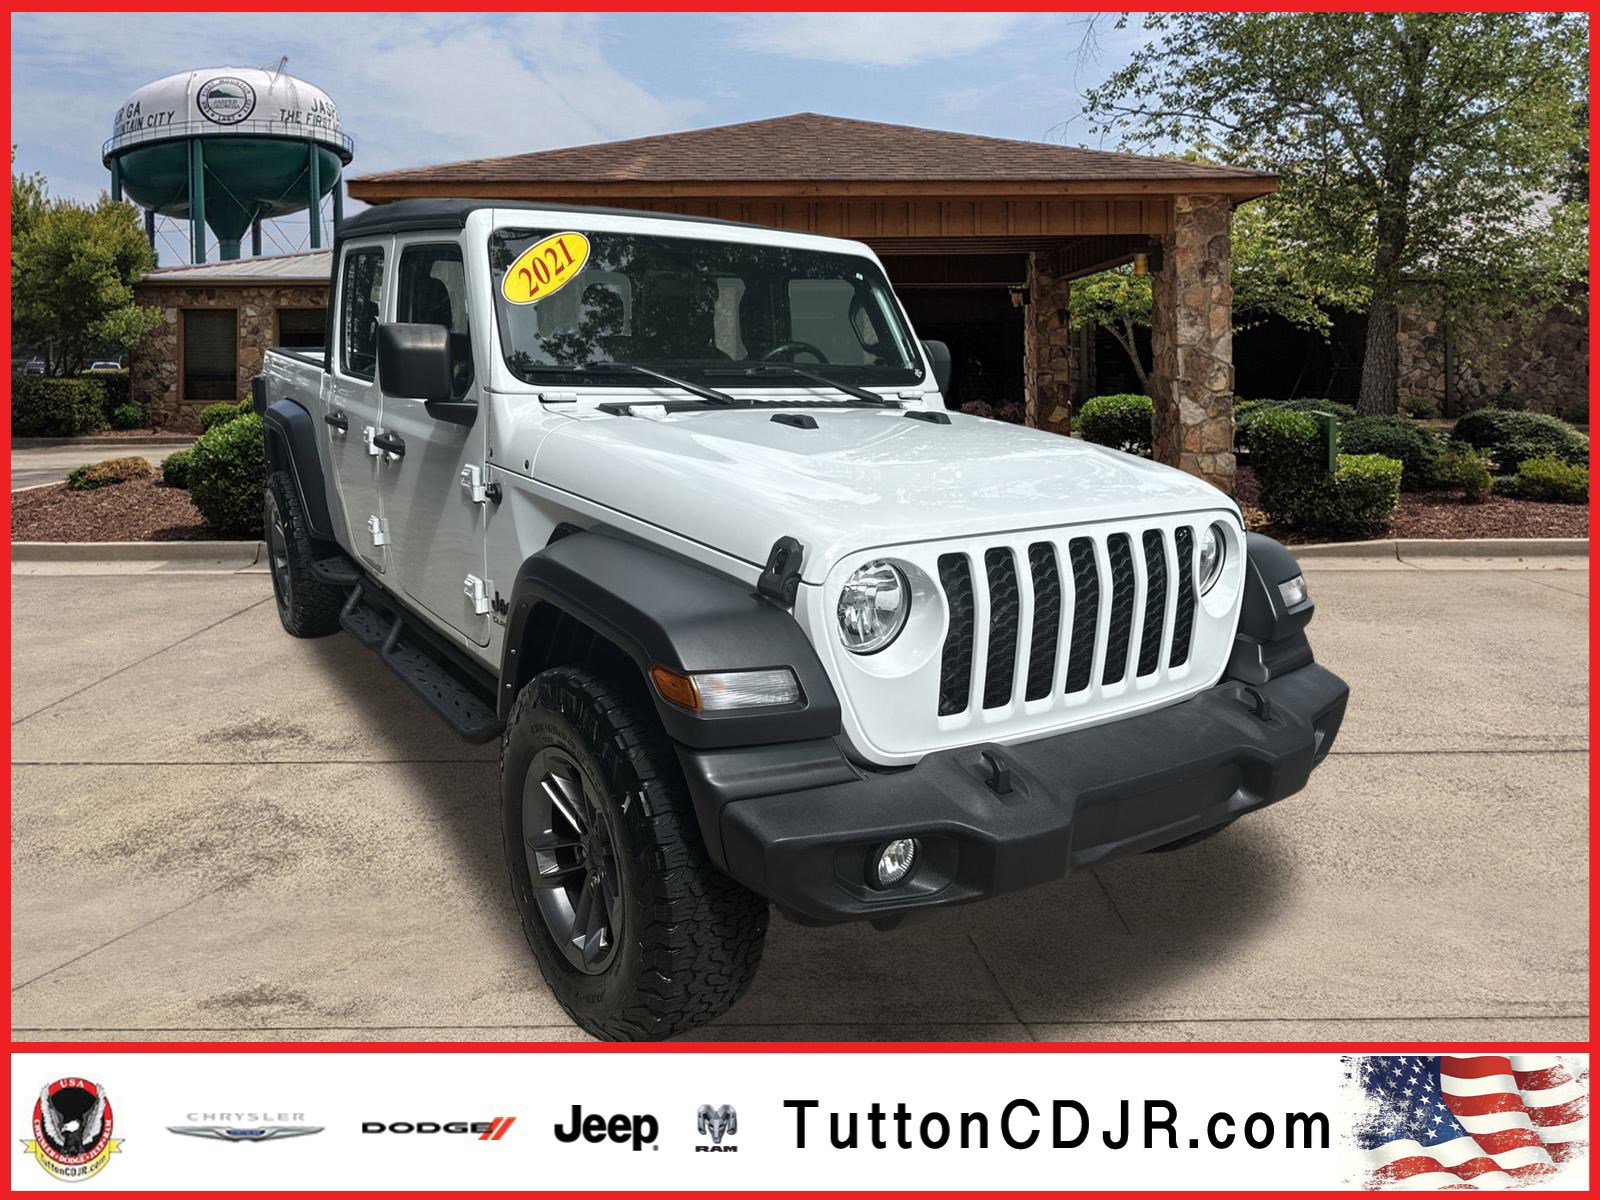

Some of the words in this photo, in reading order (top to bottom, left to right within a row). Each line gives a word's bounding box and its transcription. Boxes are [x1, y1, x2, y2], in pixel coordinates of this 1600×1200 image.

[126, 101, 141, 118] GA
[280, 109, 302, 124] THE
[147, 110, 175, 127] CITY
[518, 238, 576, 297] 2021
